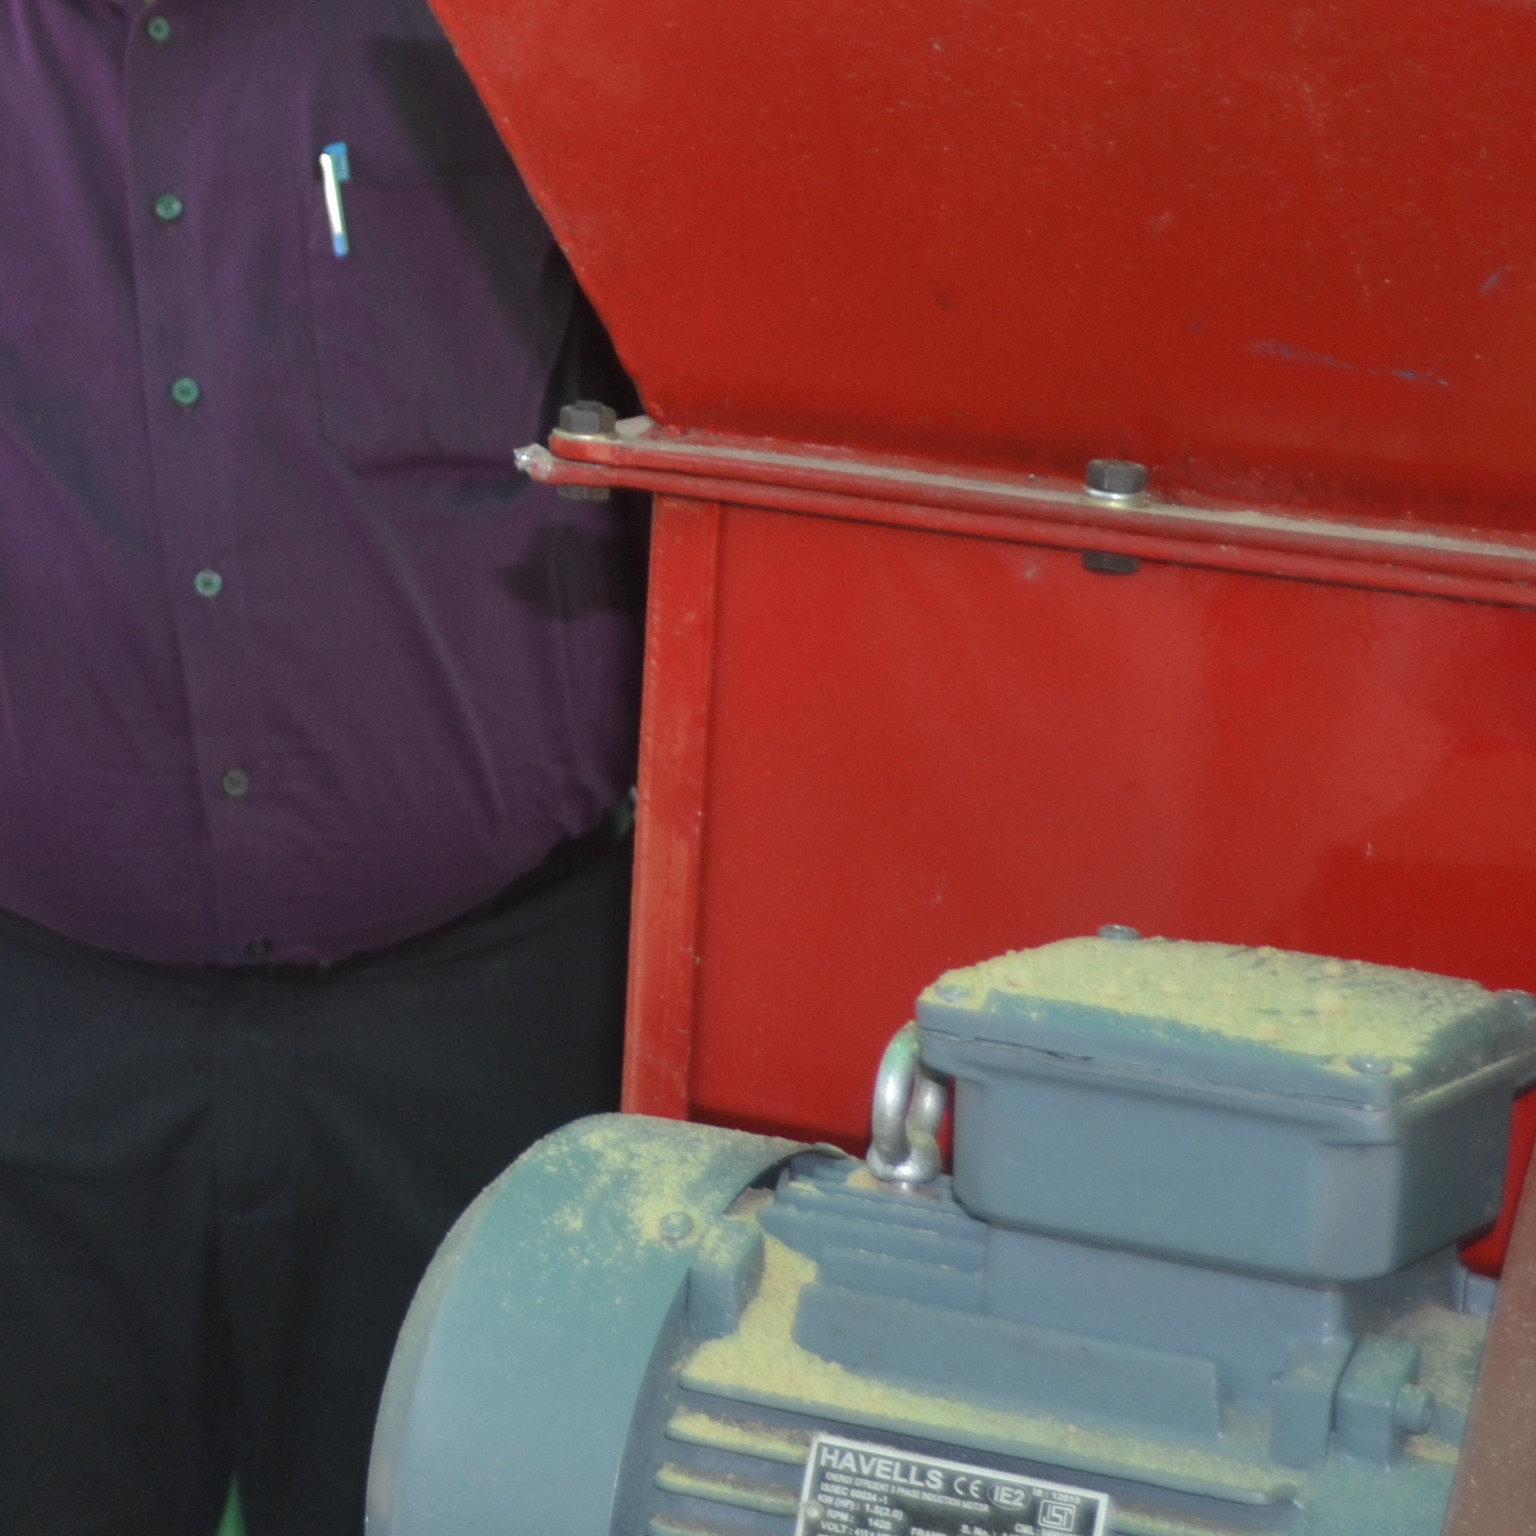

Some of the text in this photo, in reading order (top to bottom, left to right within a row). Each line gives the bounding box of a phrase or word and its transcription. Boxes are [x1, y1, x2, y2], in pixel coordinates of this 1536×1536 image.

[820, 1446, 944, 1490] HAVELLS
[817, 1493, 834, 1504] KW
[826, 1471, 853, 1485] ENERGY
[854, 1477, 889, 1492] EFFICIENT
[896, 1486, 921, 1499] PHASE
[921, 1491, 961, 1507] INDUCTION
[962, 1500, 989, 1513] MOTOR
[993, 1484, 1025, 1508] IE2
[821, 1520, 848, 1534] VOLT
